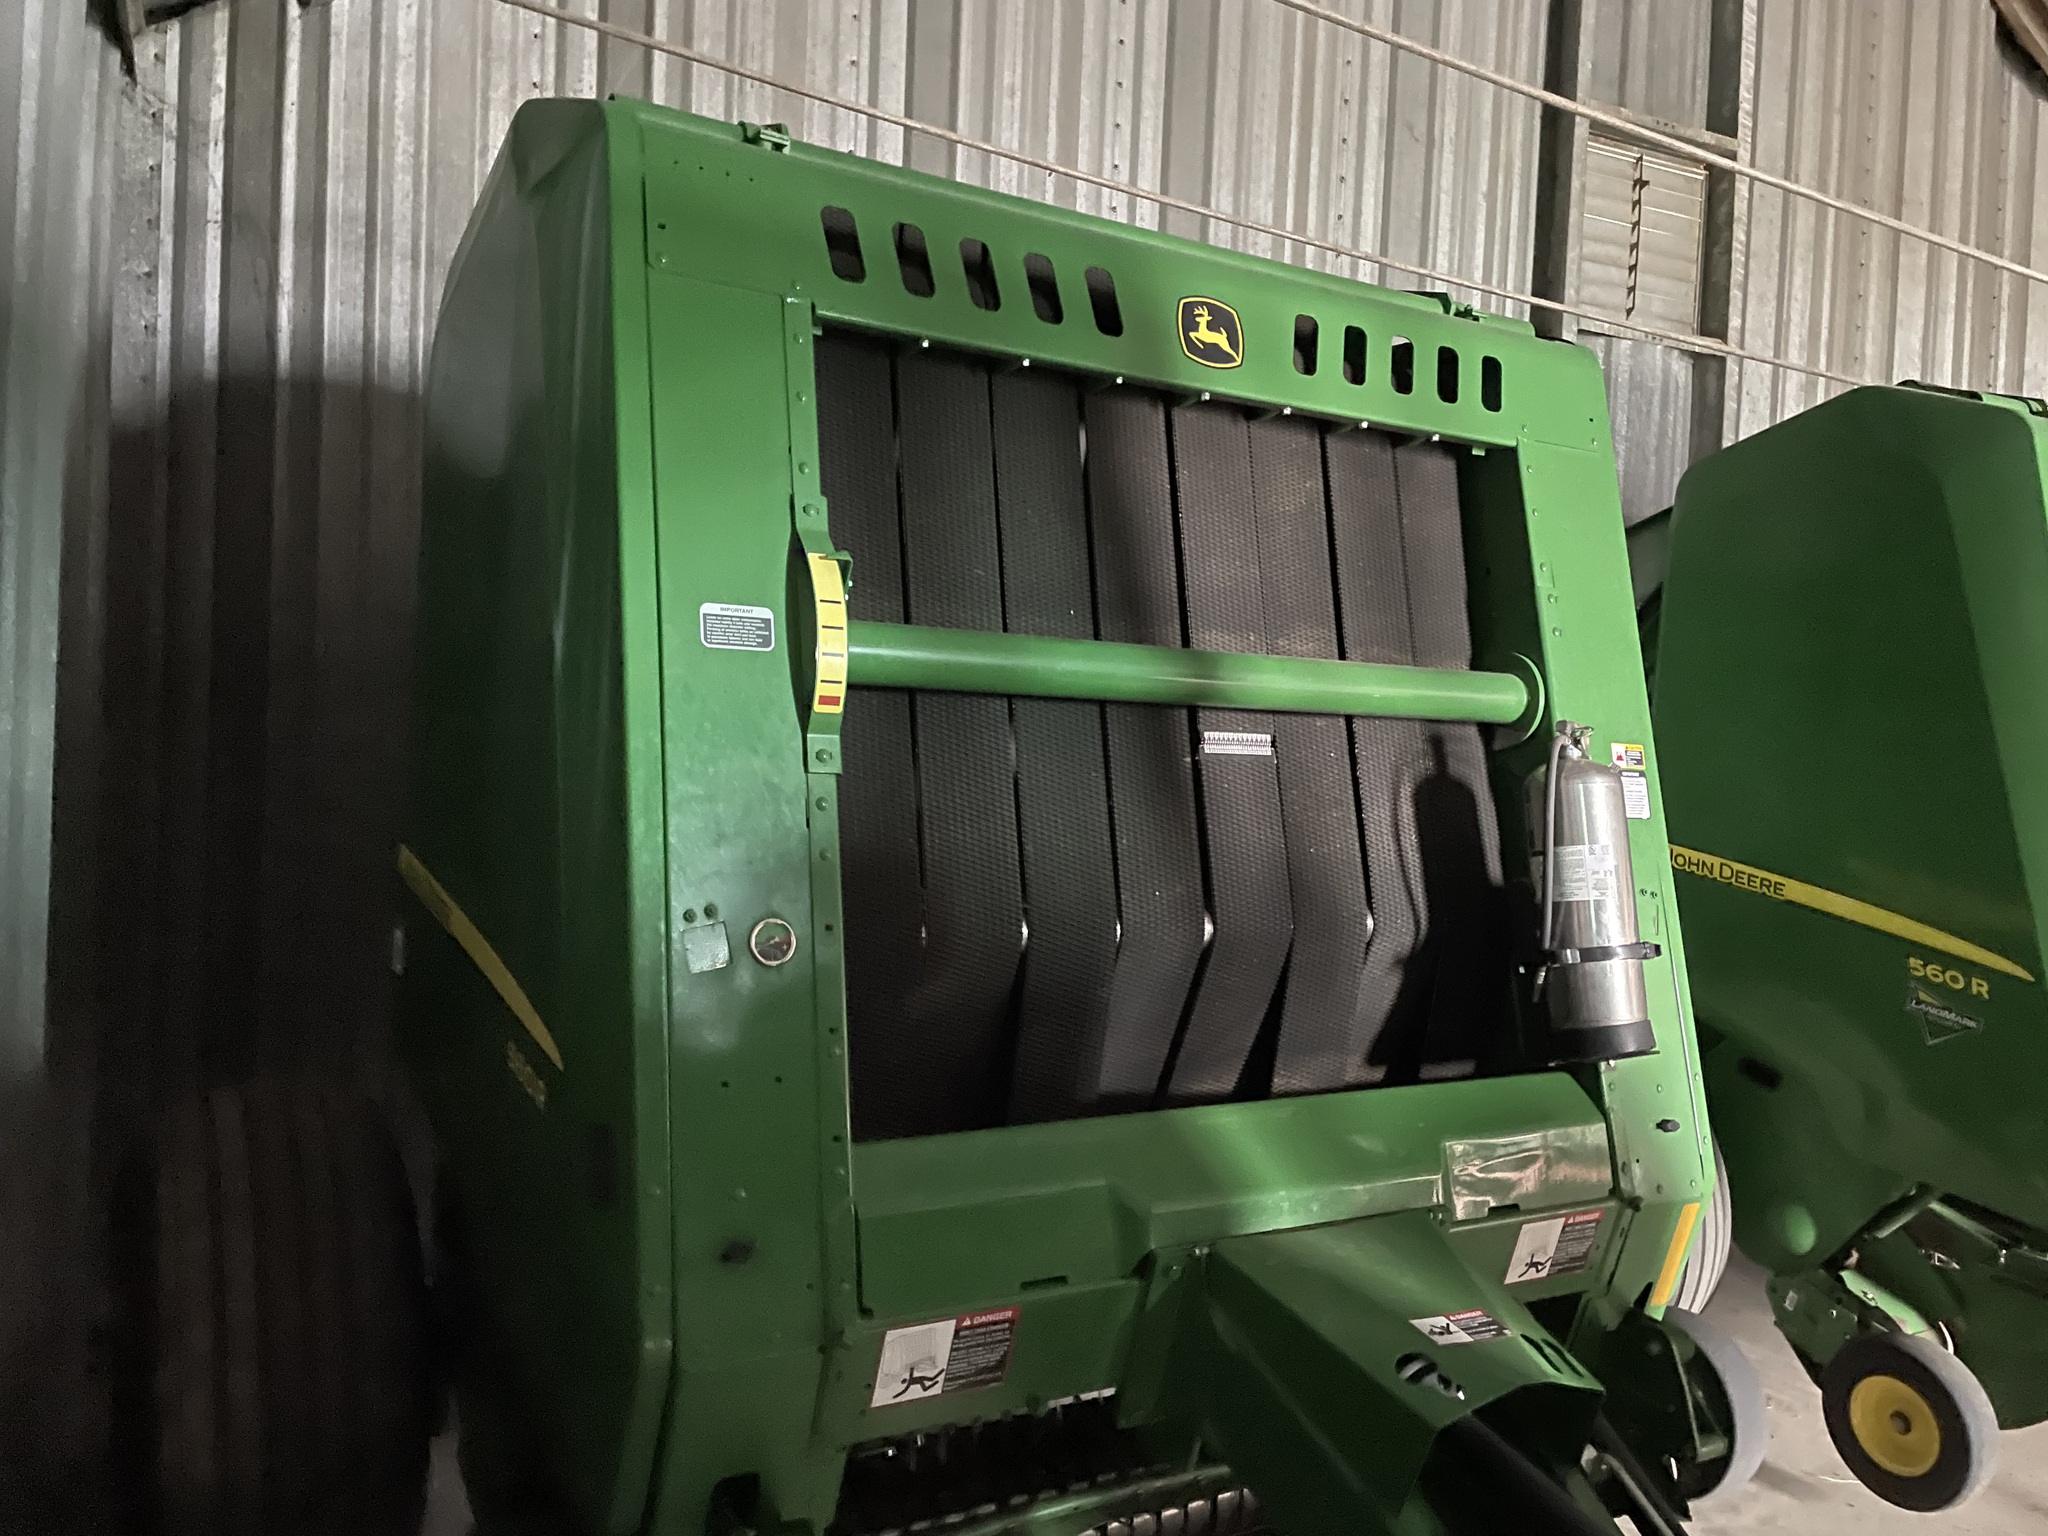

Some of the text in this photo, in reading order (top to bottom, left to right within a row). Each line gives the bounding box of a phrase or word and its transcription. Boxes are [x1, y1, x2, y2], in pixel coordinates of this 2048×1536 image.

[1719, 862, 1786, 897] DEERE
[1908, 956, 1990, 1000] 560 R
[973, 1310, 1013, 1324] DANGER
